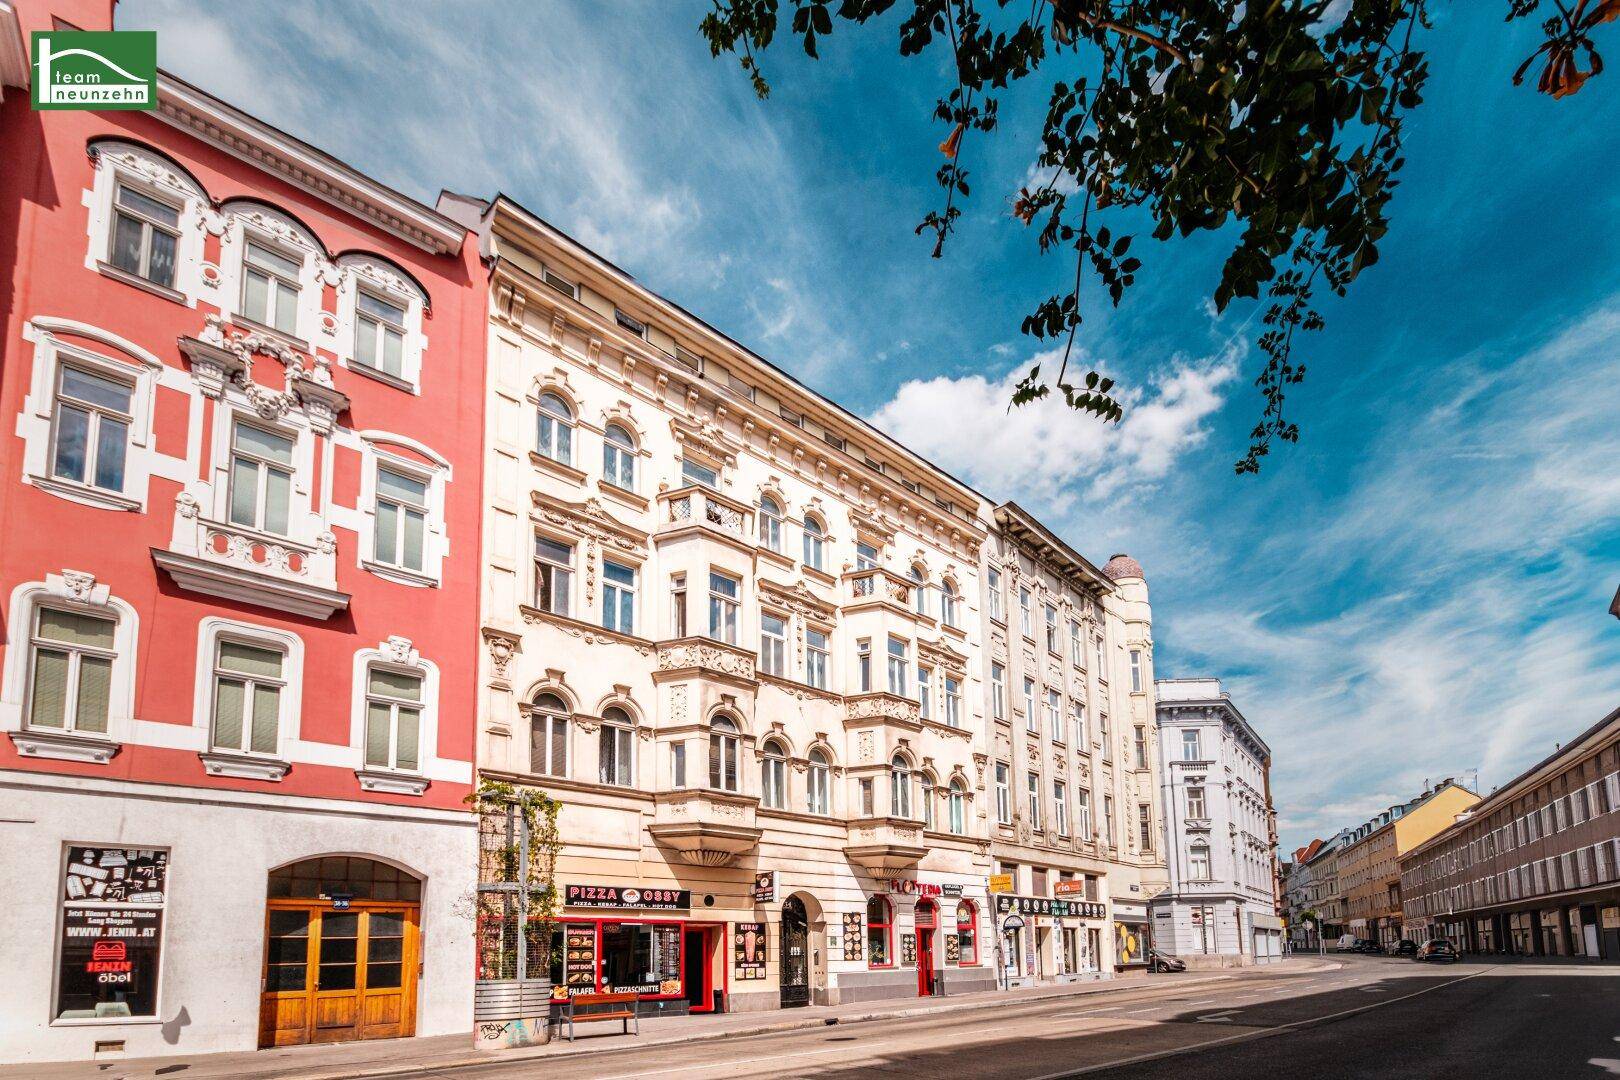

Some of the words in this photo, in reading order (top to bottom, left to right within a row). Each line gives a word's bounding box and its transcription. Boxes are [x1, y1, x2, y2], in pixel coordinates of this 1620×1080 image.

[570, 886, 617, 900] PIZZA
[643, 890, 680, 902] OSSY
[86, 961, 133, 972] JENIN
[569, 987, 595, 996] FALAFEL
[614, 985, 660, 994] PIZZASCHNITTE
